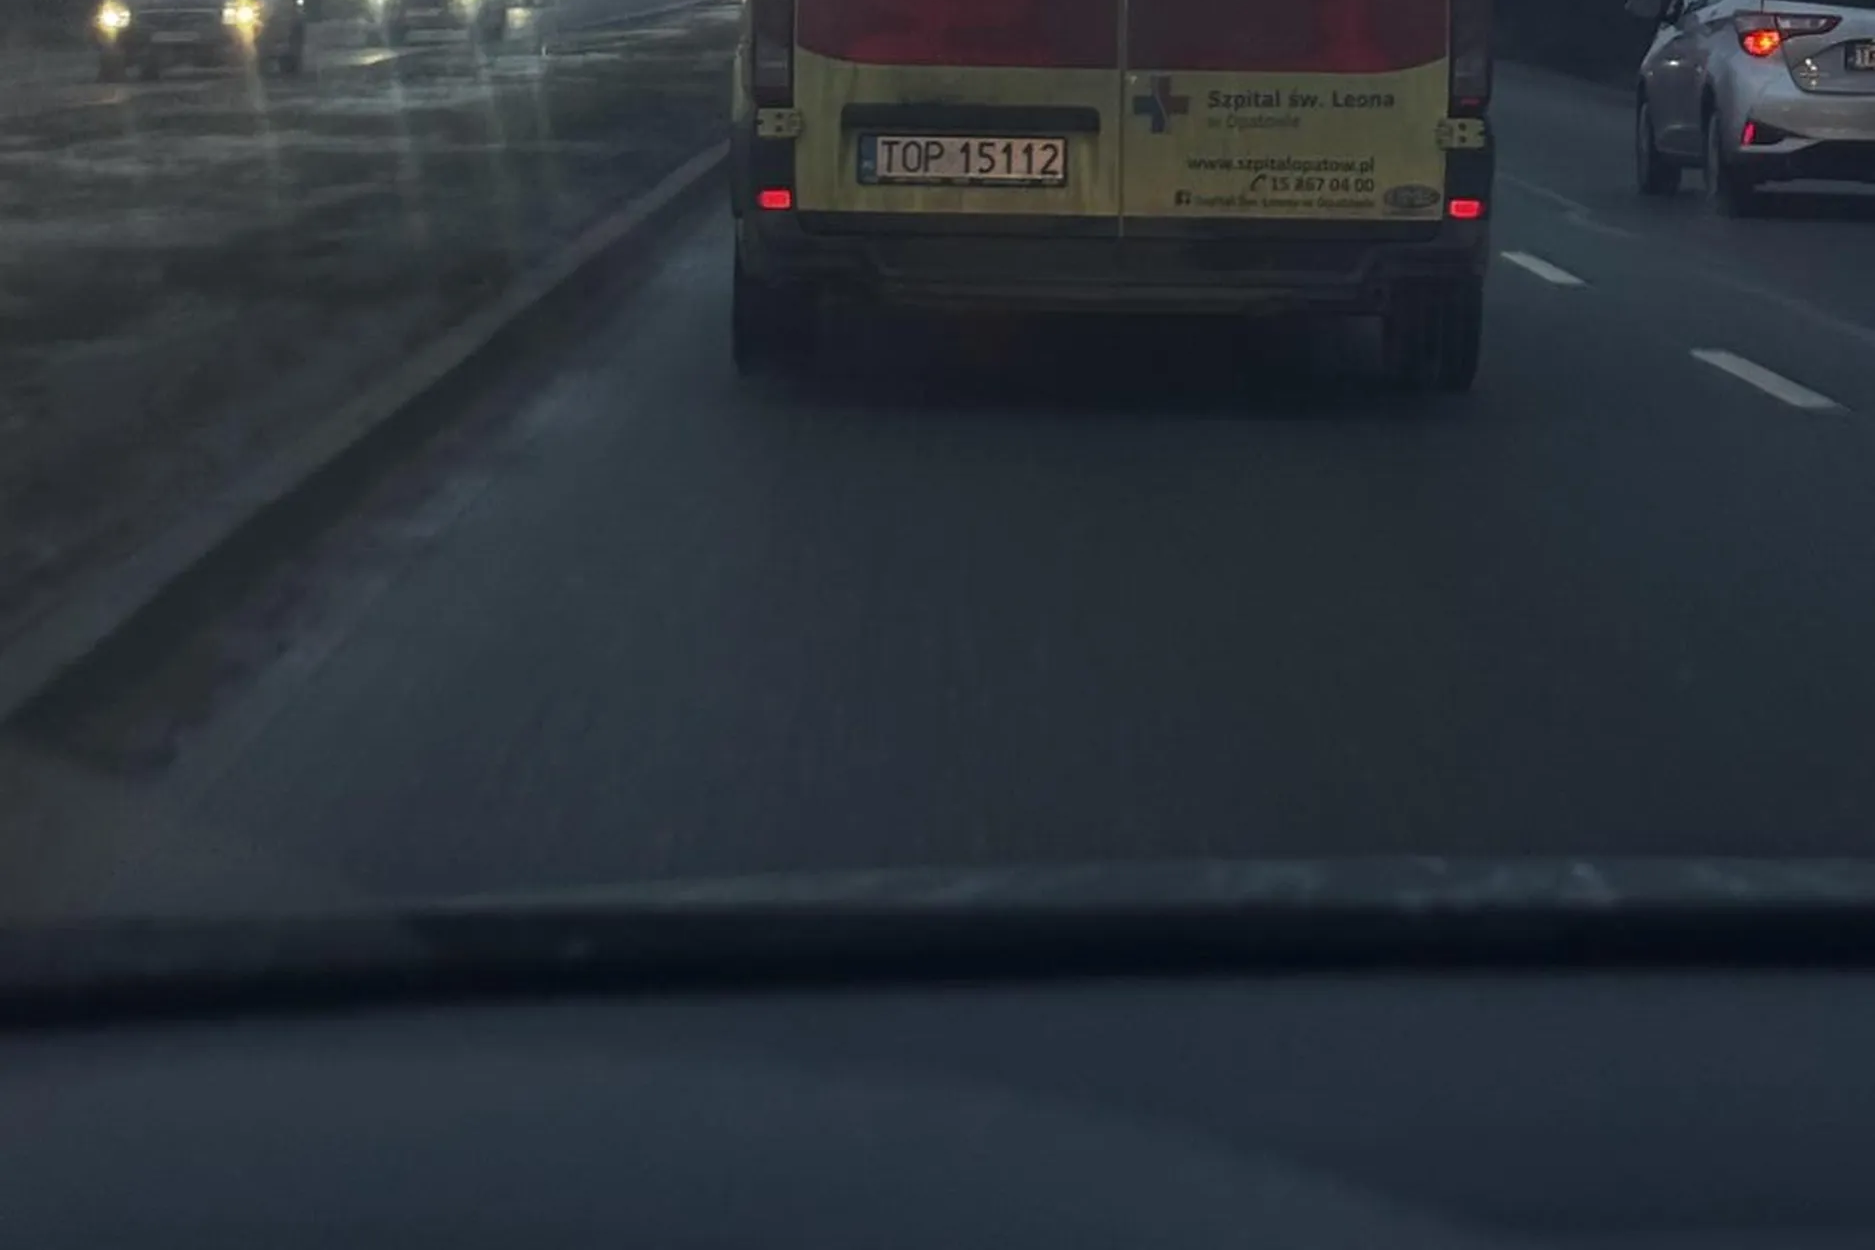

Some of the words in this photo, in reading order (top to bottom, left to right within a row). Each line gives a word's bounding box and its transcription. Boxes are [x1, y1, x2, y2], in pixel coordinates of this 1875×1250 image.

[1208, 90, 1280, 111] Szpital
[1288, 86, 1324, 108] św.
[1333, 90, 1394, 108] Leona
[881, 140, 944, 173] TOP
[960, 141, 1060, 175] 15112
[1272, 177, 1290, 192] 15
[1329, 177, 1349, 192] 04
[1355, 177, 1375, 192] 00
